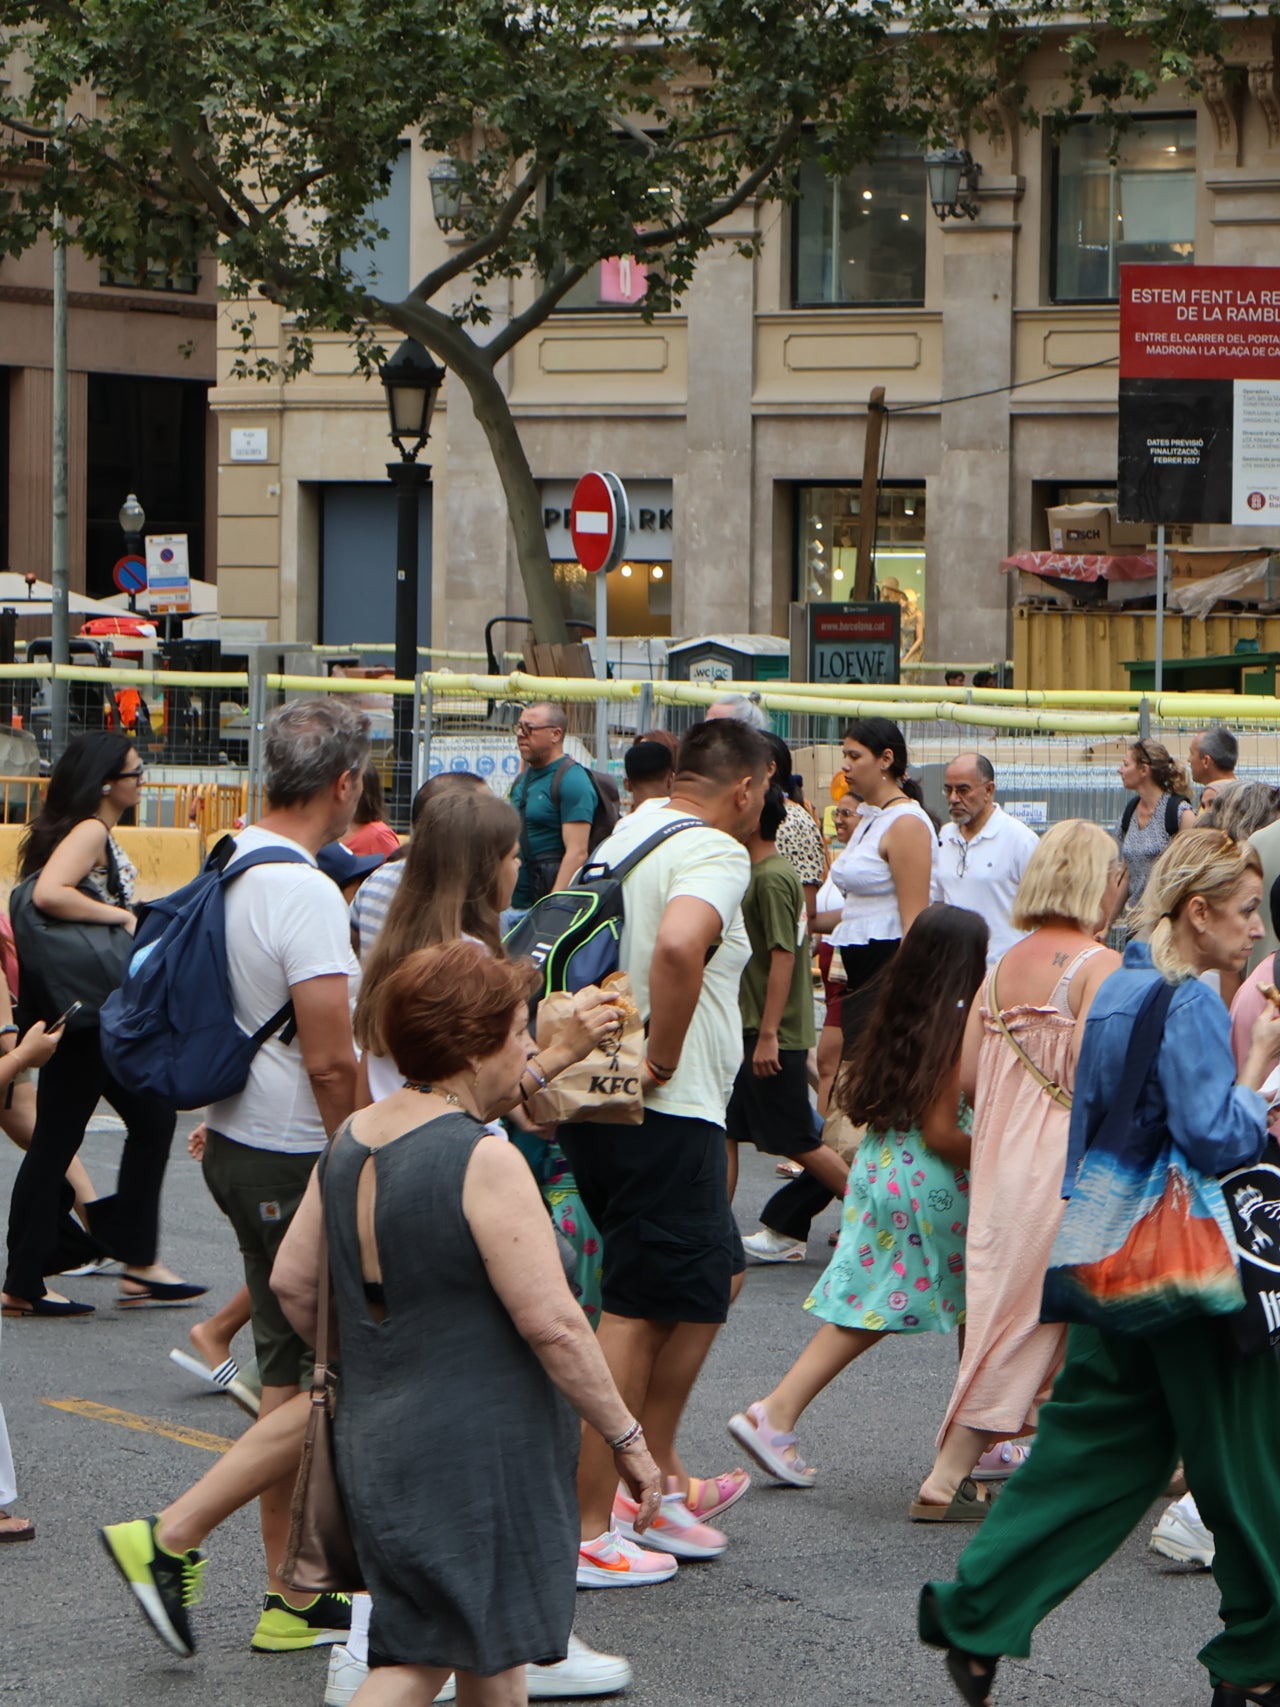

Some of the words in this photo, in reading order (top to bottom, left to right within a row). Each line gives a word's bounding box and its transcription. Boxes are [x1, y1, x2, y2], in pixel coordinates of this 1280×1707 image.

[1131, 288, 1186, 304] ESTEM
[1191, 289, 1233, 305] FENT
[1236, 290, 1256, 305] LA
[1176, 306, 1198, 321] DE
[1202, 307, 1223, 322] LA
[1135, 332, 1168, 343] ENTRE
[1170, 333, 1182, 343] EL
[1184, 333, 1225, 344] CARRER
[1227, 334, 1245, 344] DEL
[1146, 345, 1196, 356] MADRONA
[1204, 346, 1217, 356] LA
[1219, 346, 1250, 358] PLAÇA
[1252, 346, 1266, 357] DE
[1146, 438, 1170, 447] DATES
[1171, 437, 1204, 447] PREVISIÓ
[1153, 456, 1183, 465] FEBRER
[1183, 456, 1201, 465] 2027
[821, 620, 886, 632] www.barcelona.cat
[819, 650, 886, 679] LOEWE
[588, 1075, 640, 1096] KFC
